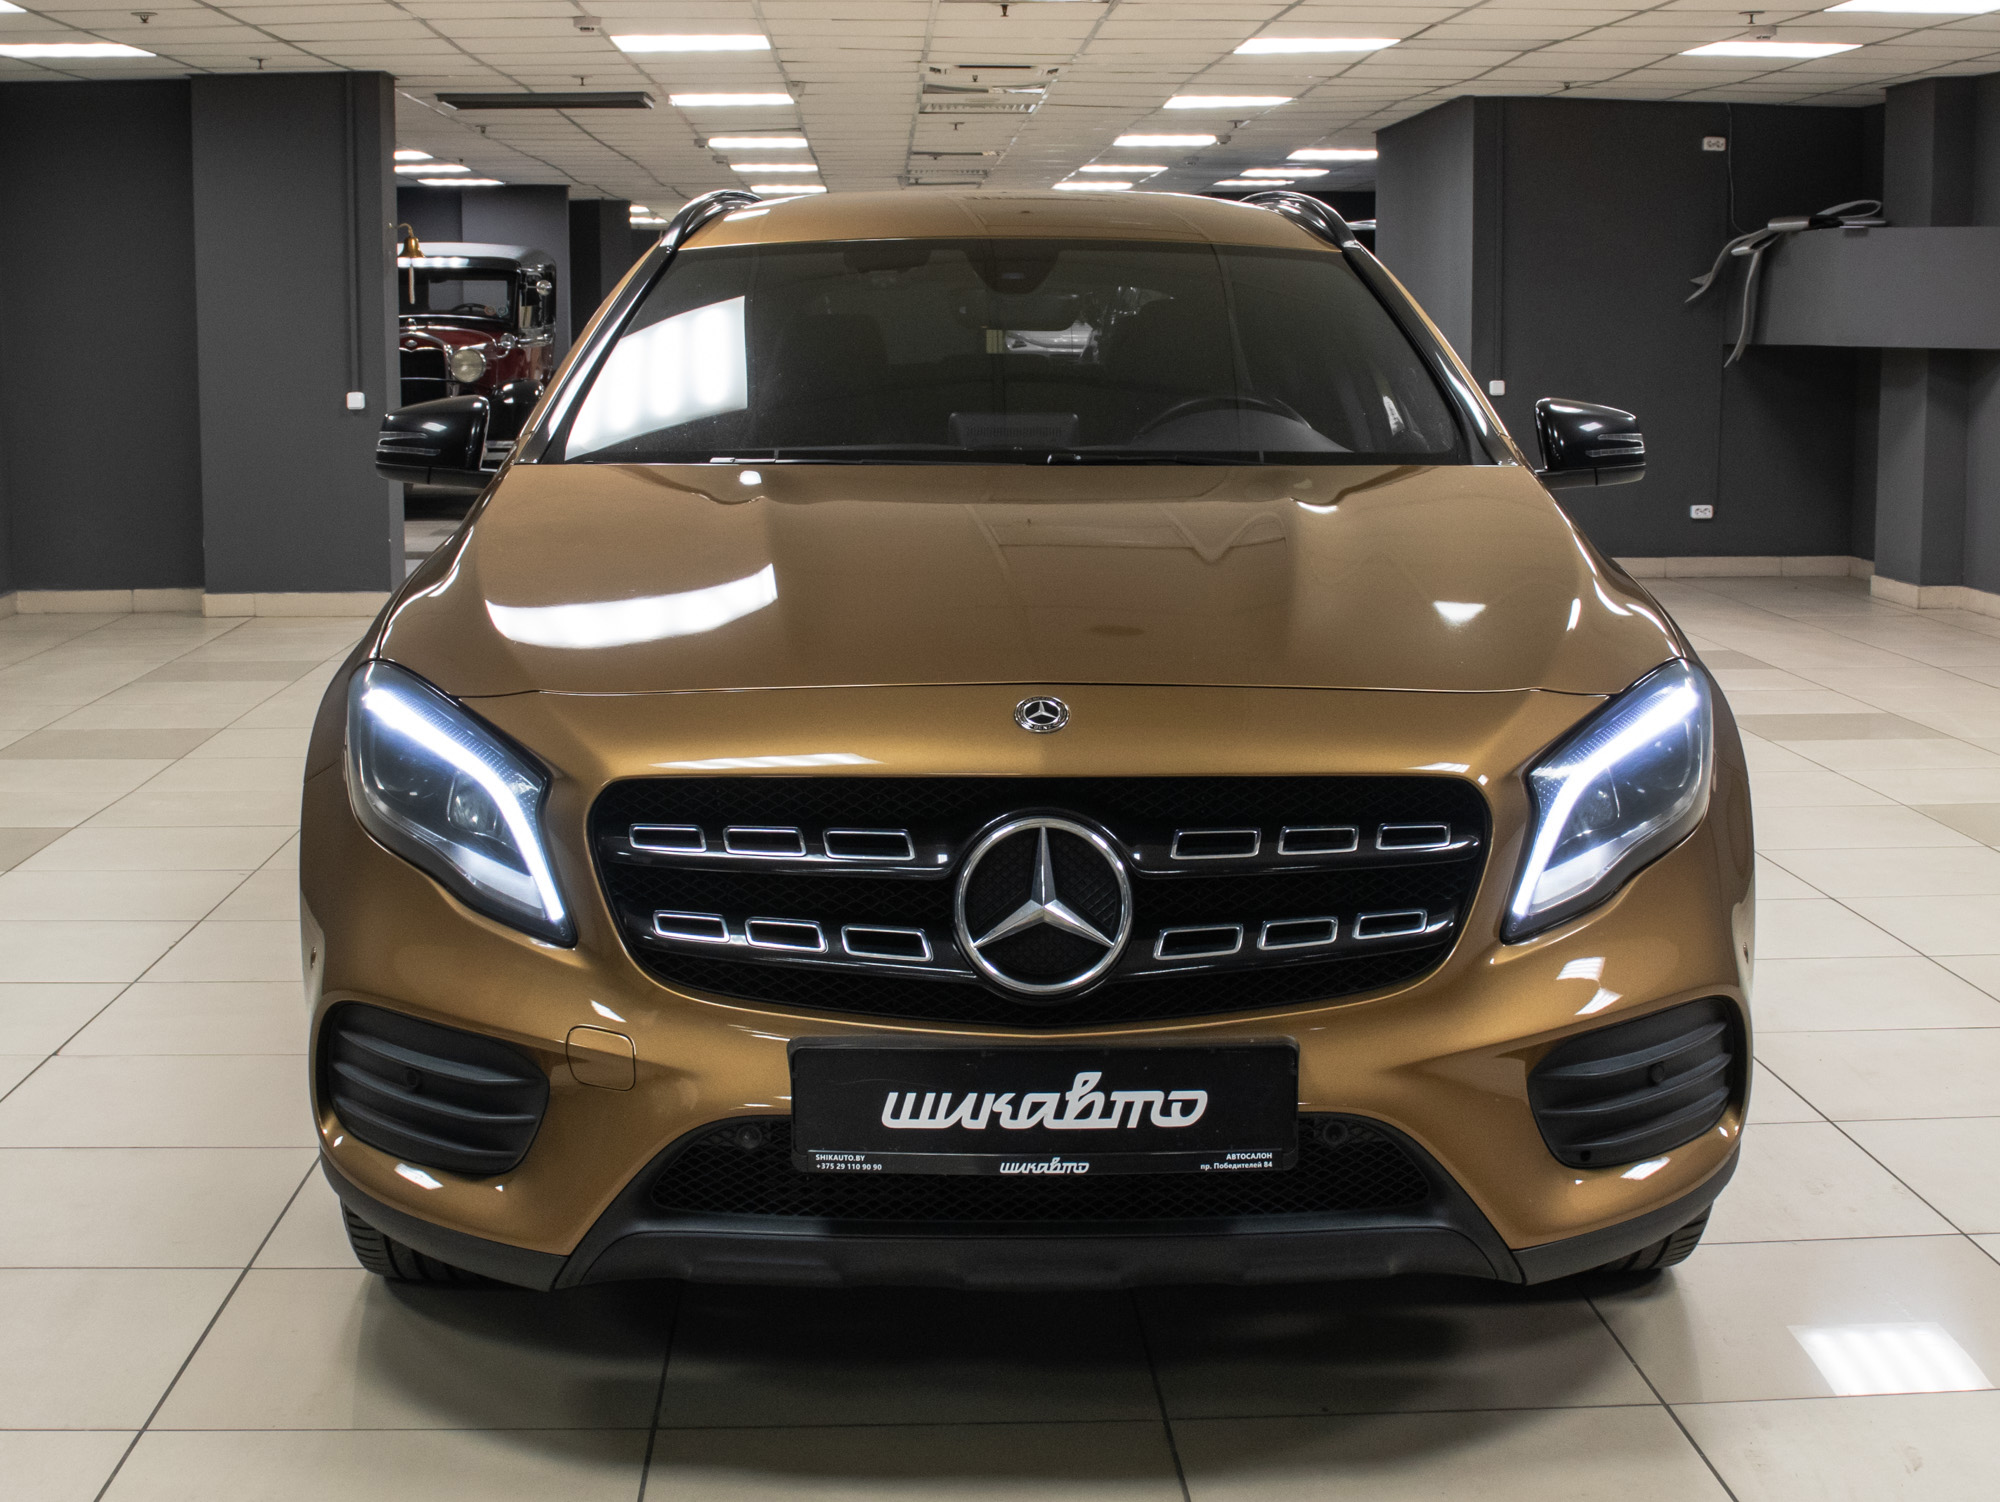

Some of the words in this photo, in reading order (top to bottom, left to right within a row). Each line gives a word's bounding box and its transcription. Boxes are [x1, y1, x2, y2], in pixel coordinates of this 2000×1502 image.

[815, 1154, 866, 1162] SHIKAUTO.BY
[1226, 1152, 1273, 1160] АВТОСАЛОН
[816, 1162, 834, 1170] +375
[1213, 1161, 1262, 1169] Победителей
